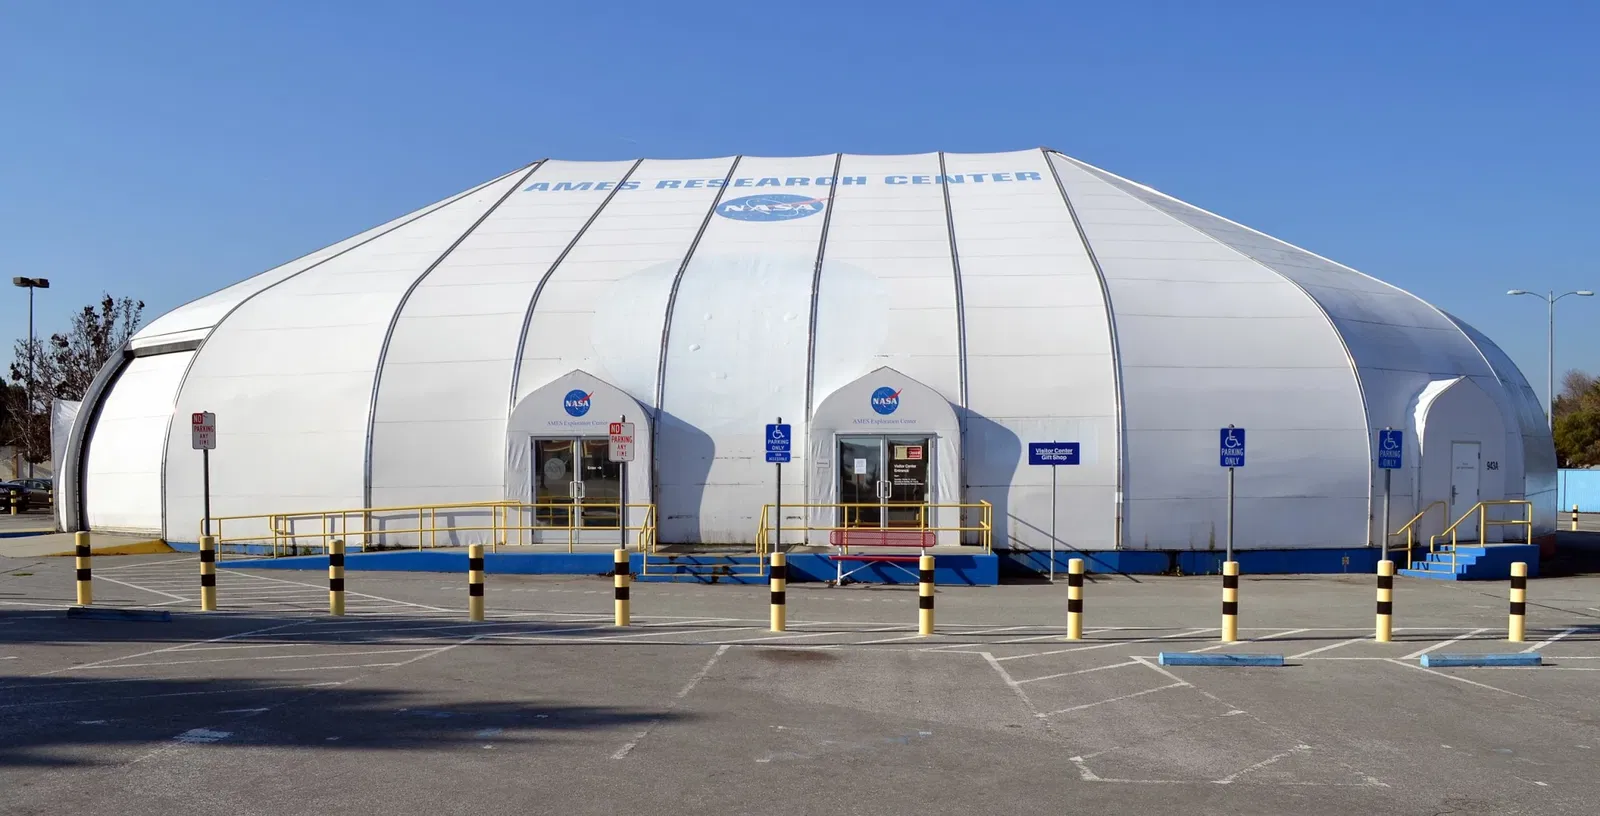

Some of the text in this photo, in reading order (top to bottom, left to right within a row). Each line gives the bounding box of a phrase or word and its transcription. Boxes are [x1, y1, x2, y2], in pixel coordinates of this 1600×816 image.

[523, 171, 1042, 192] AMES RESEARCH CENTER
[725, 203, 816, 213] NASA
[872, 397, 898, 405] NASA
[193, 414, 202, 423] NO
[194, 425, 214, 433] PARKING
[611, 424, 620, 433] NO
[611, 435, 632, 443] PARKING
[1221, 448, 1243, 456] PARKING
[1380, 450, 1401, 458] PARKING
[1225, 457, 1240, 465] ONLY
[1486, 461, 1499, 470] 943A
